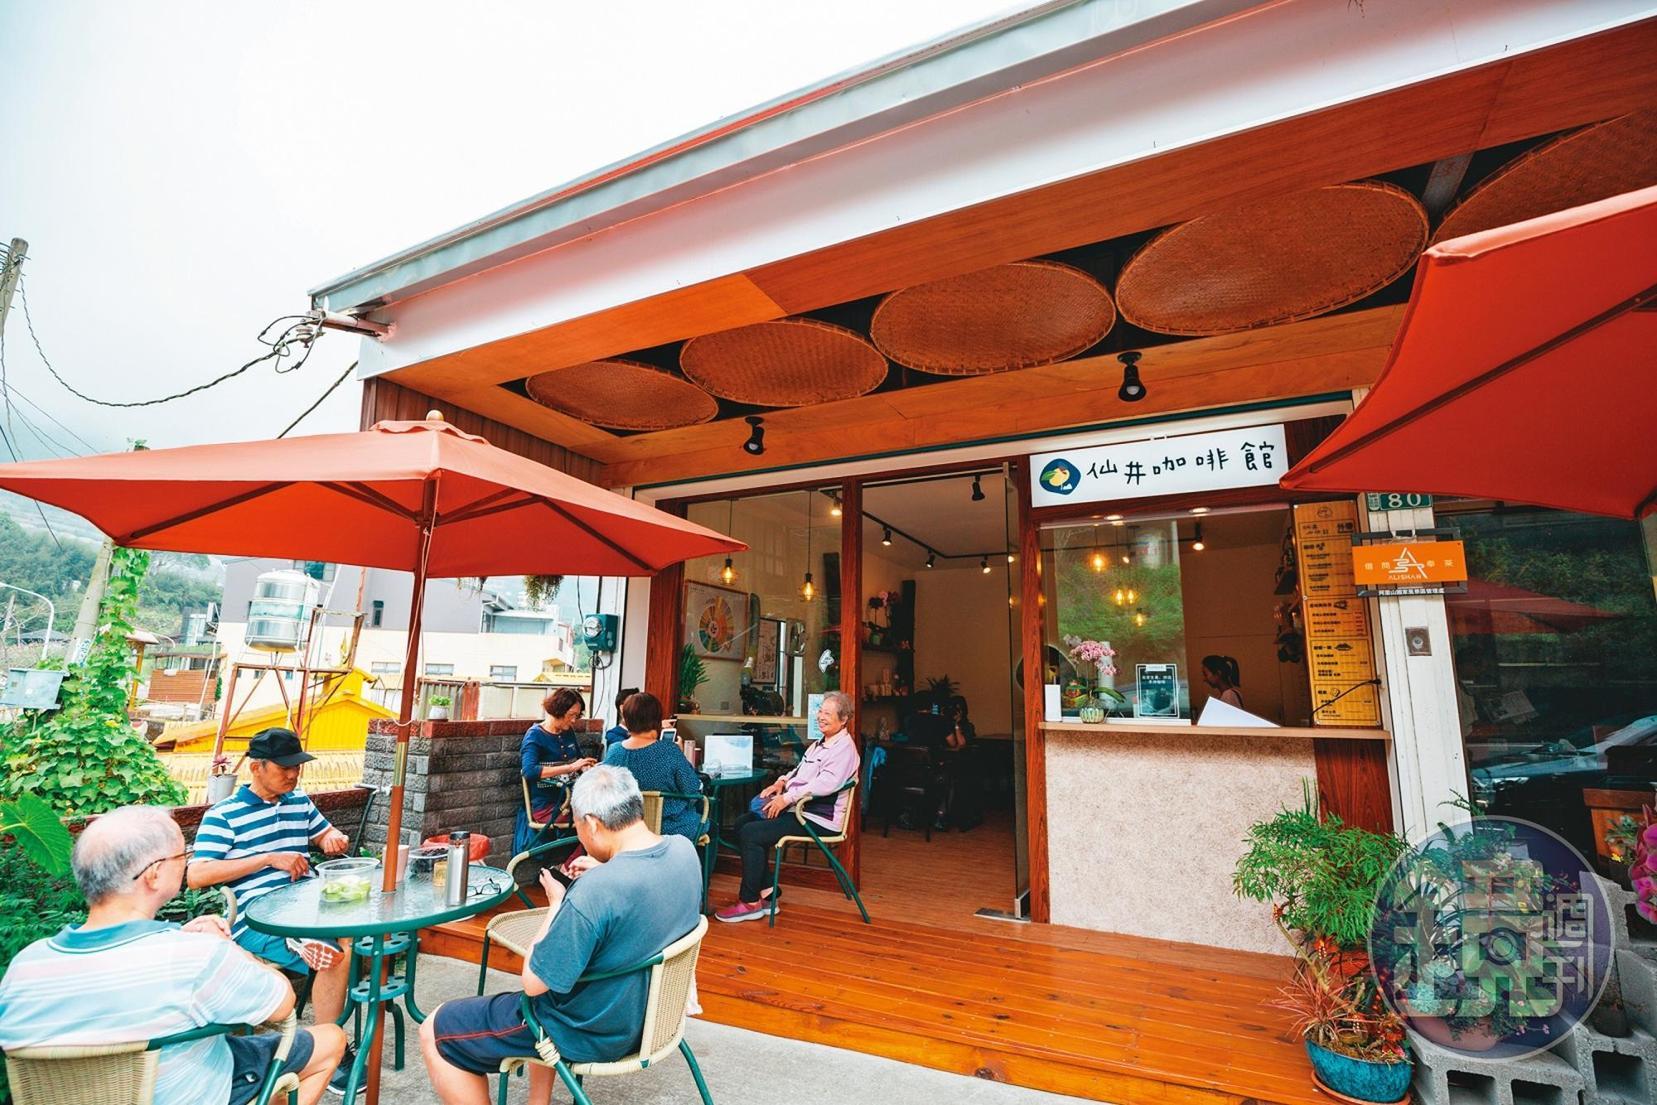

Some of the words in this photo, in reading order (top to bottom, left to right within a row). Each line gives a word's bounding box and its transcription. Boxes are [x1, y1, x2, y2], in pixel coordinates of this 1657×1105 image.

[1086, 441, 1275, 486] 仙井咖啡館
[1388, 492, 1422, 508] 80
